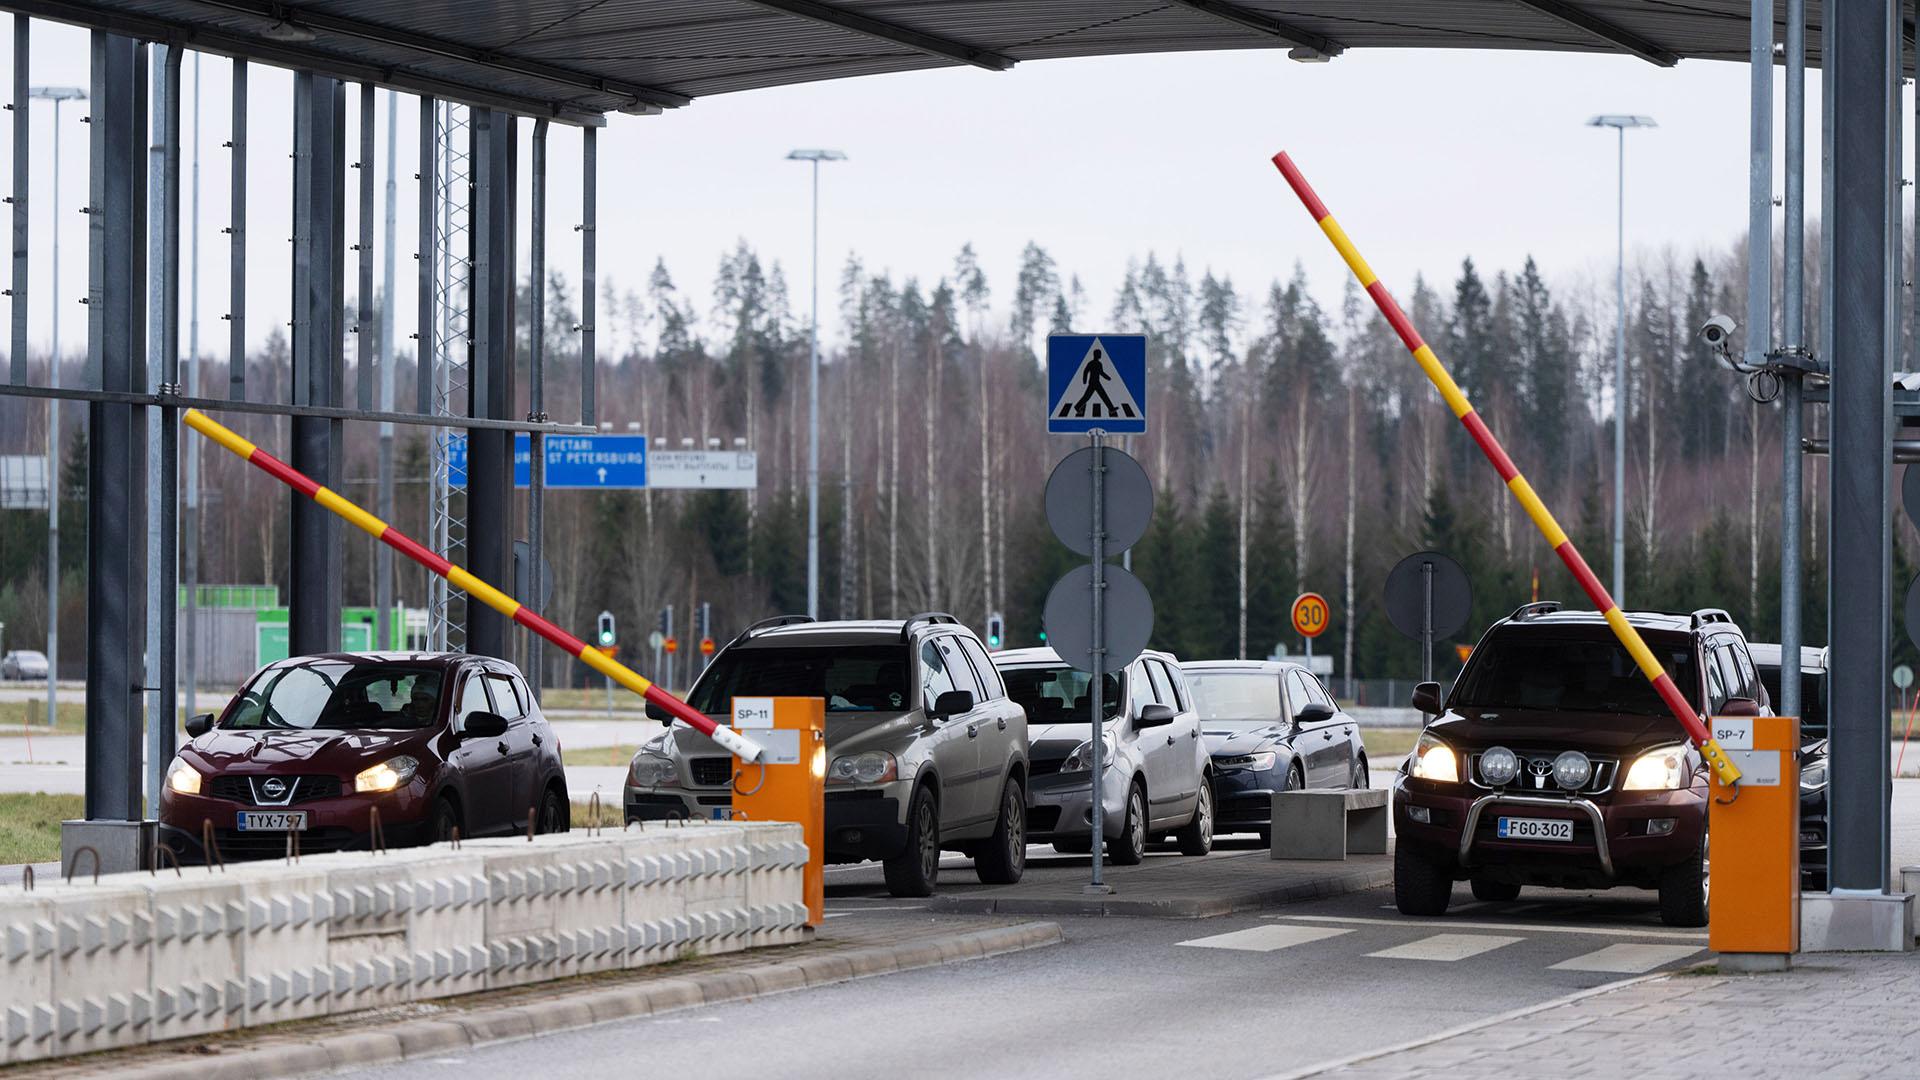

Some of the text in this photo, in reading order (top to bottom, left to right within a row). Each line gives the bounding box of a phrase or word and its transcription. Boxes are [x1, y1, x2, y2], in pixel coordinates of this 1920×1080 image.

[548, 440, 593, 451] PIETARI
[549, 452, 643, 464] ST PETERSBURG
[1300, 605, 1322, 626] 30
[738, 709, 769, 720] SP-11
[1717, 729, 1746, 740] SP-7
[1510, 821, 1569, 838] FGO-302
